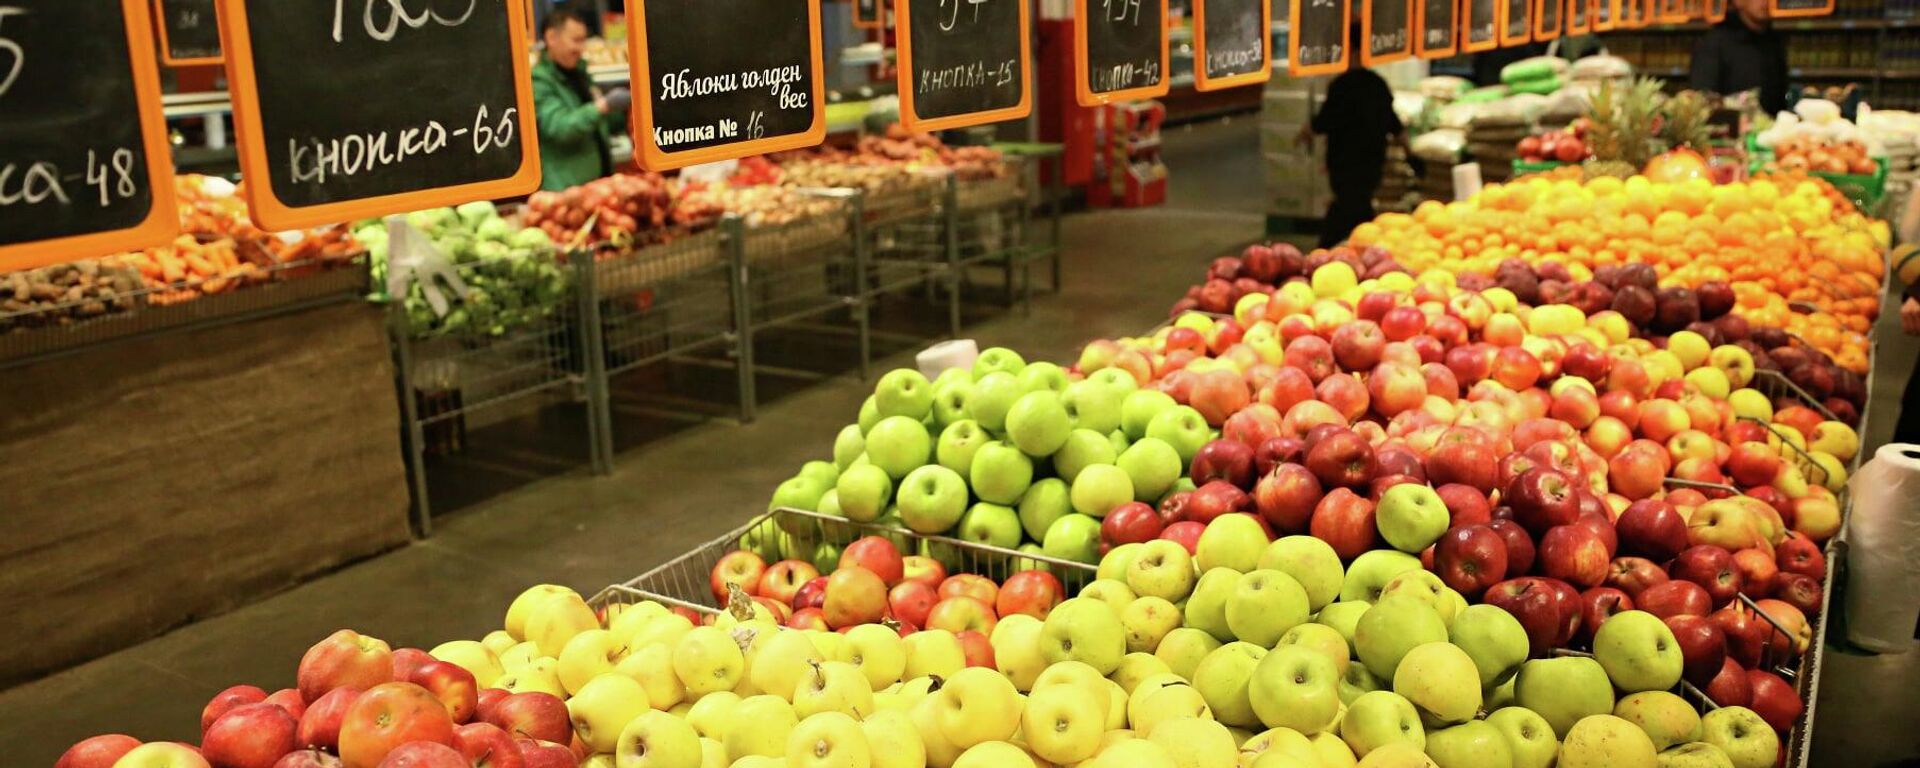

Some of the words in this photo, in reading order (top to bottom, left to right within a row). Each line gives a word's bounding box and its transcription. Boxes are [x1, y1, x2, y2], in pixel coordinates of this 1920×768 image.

[660, 68, 739, 101] Яблоки
[740, 64, 802, 96] голден
[778, 83, 808, 110] вес
[652, 124, 715, 146] Кнопка
